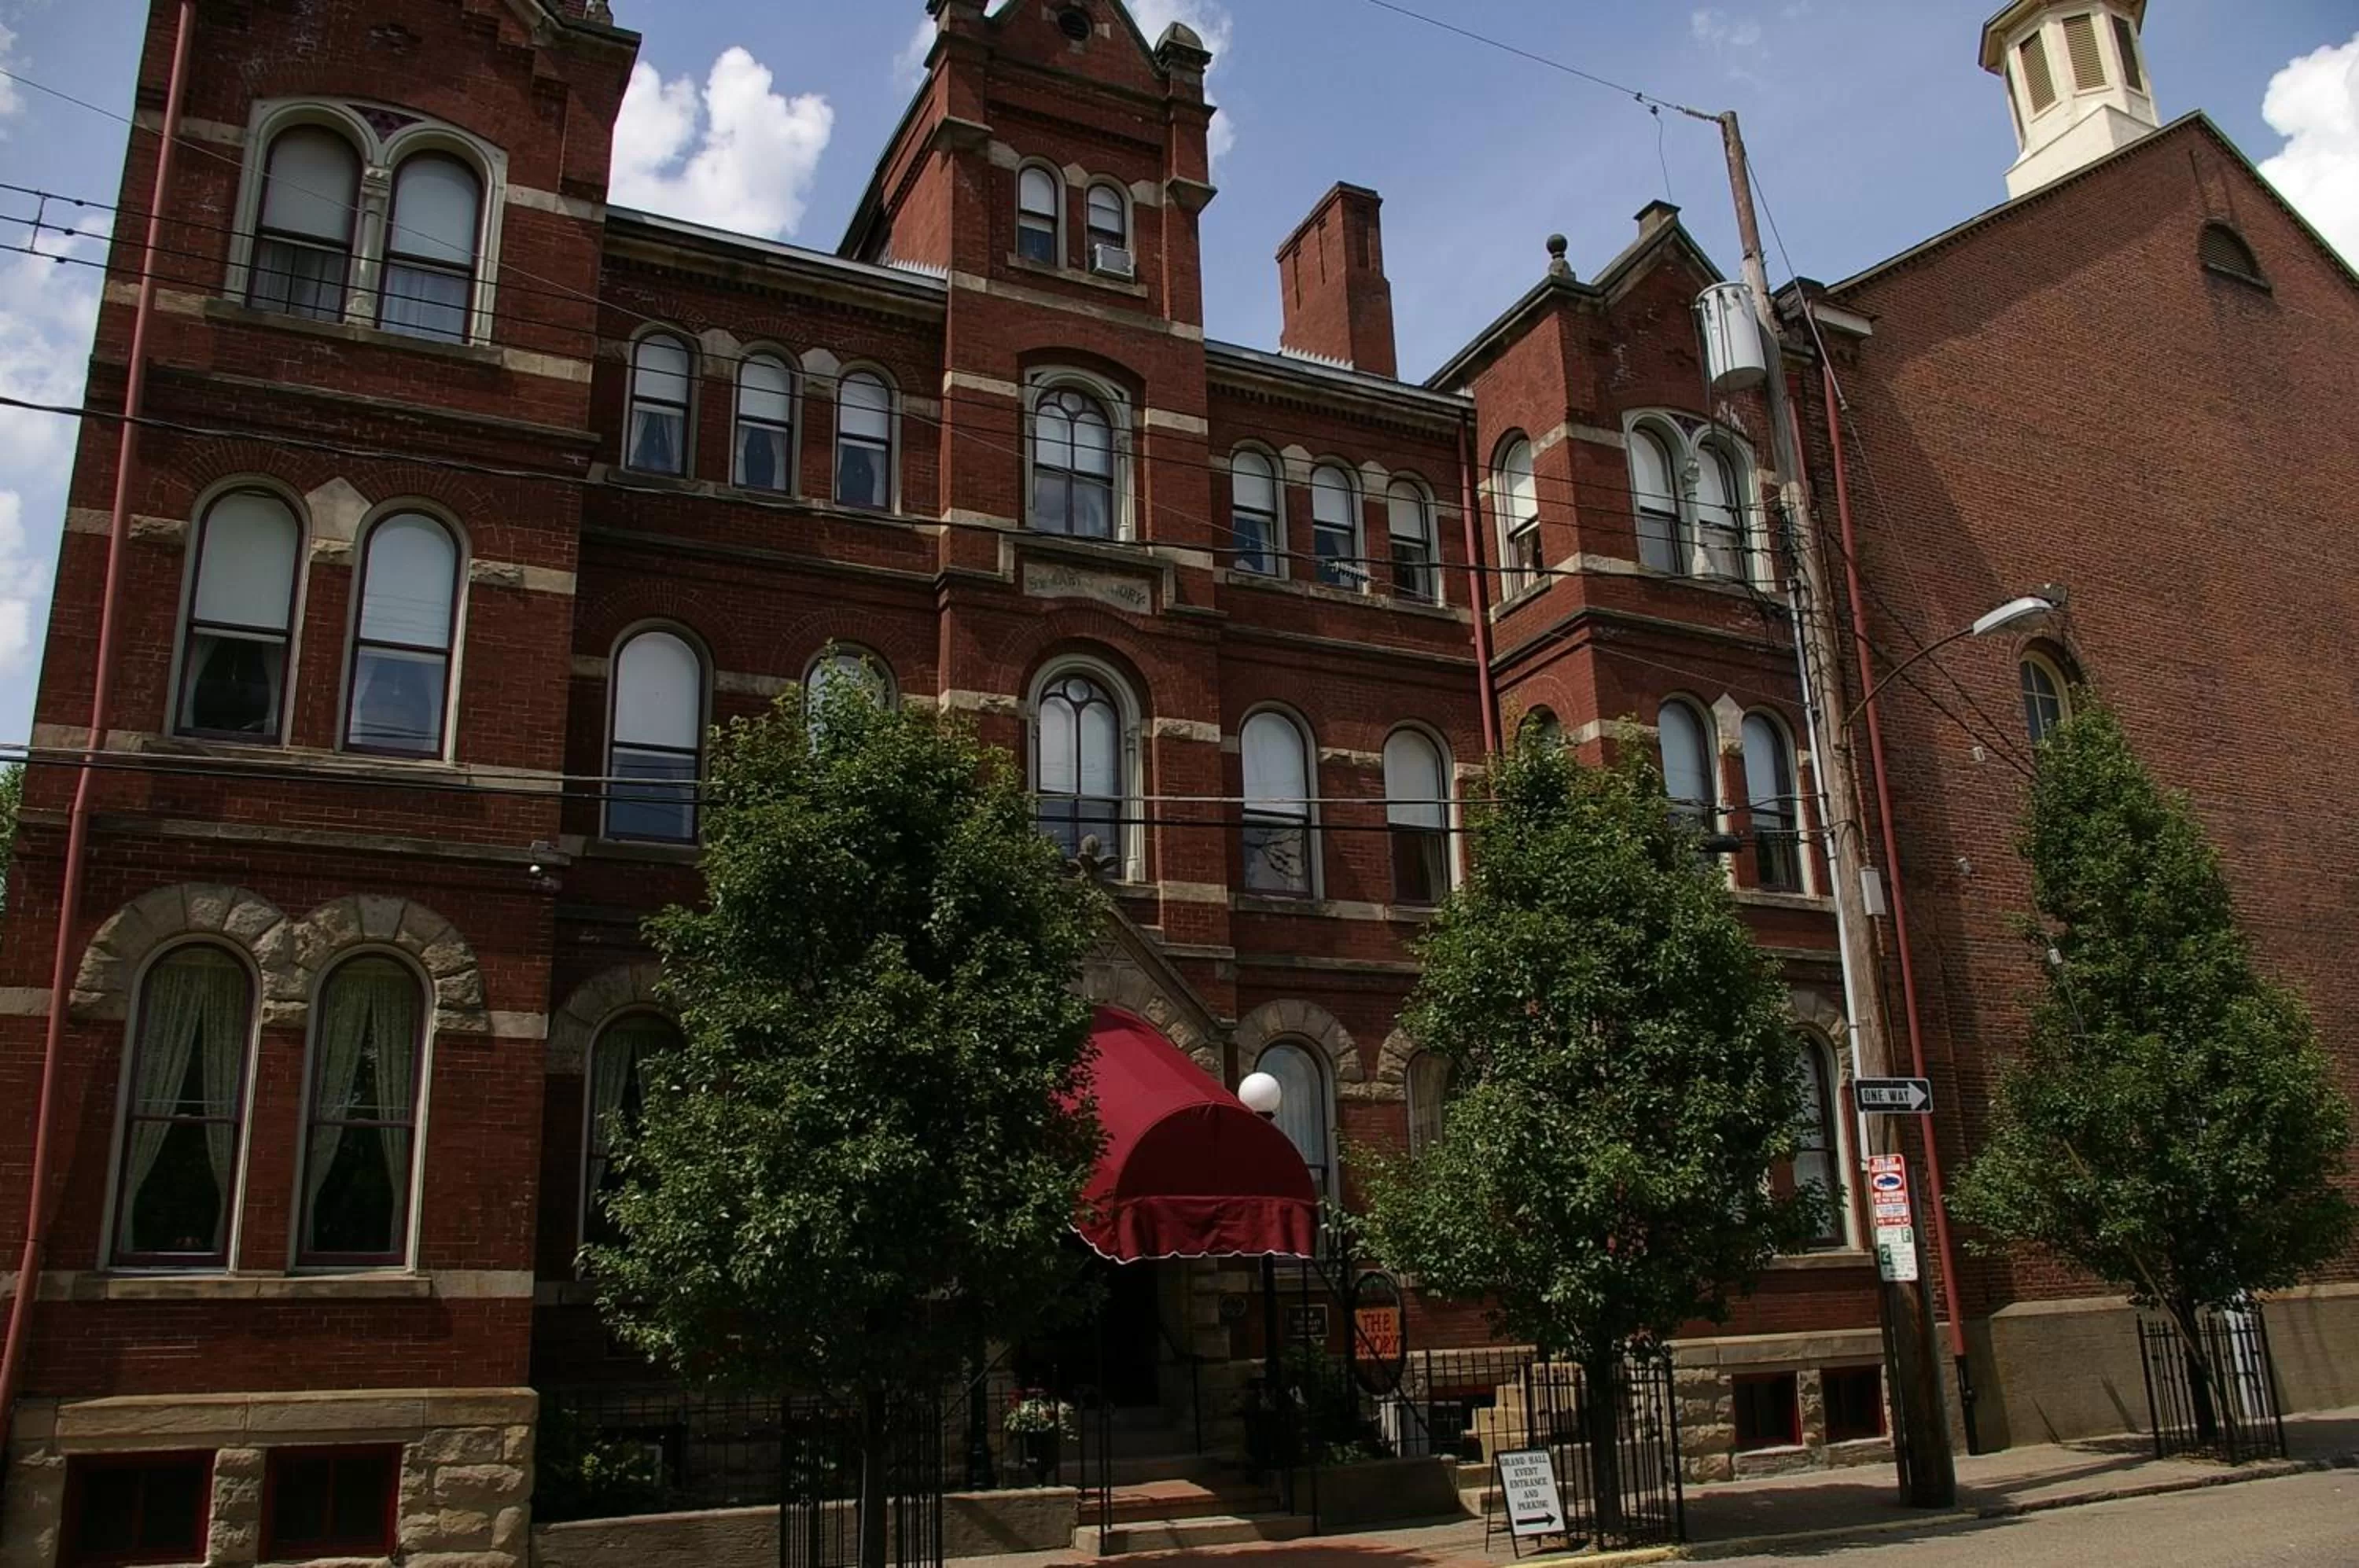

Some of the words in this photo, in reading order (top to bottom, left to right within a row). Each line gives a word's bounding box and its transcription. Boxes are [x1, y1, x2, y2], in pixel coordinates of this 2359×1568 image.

[1863, 1088, 1884, 1102] ONE
[1889, 1088, 1909, 1102] WAY
[1362, 1312, 1391, 1332] THE
[1500, 1456, 1525, 1467] GRAND
[1528, 1454, 1548, 1464] HALL
[1514, 1467, 1539, 1477] EVENT
[1509, 1477, 1548, 1489] ENTRANCE
[1523, 1489, 1539, 1499] AND
[1517, 1500, 1549, 1511] PARKING
